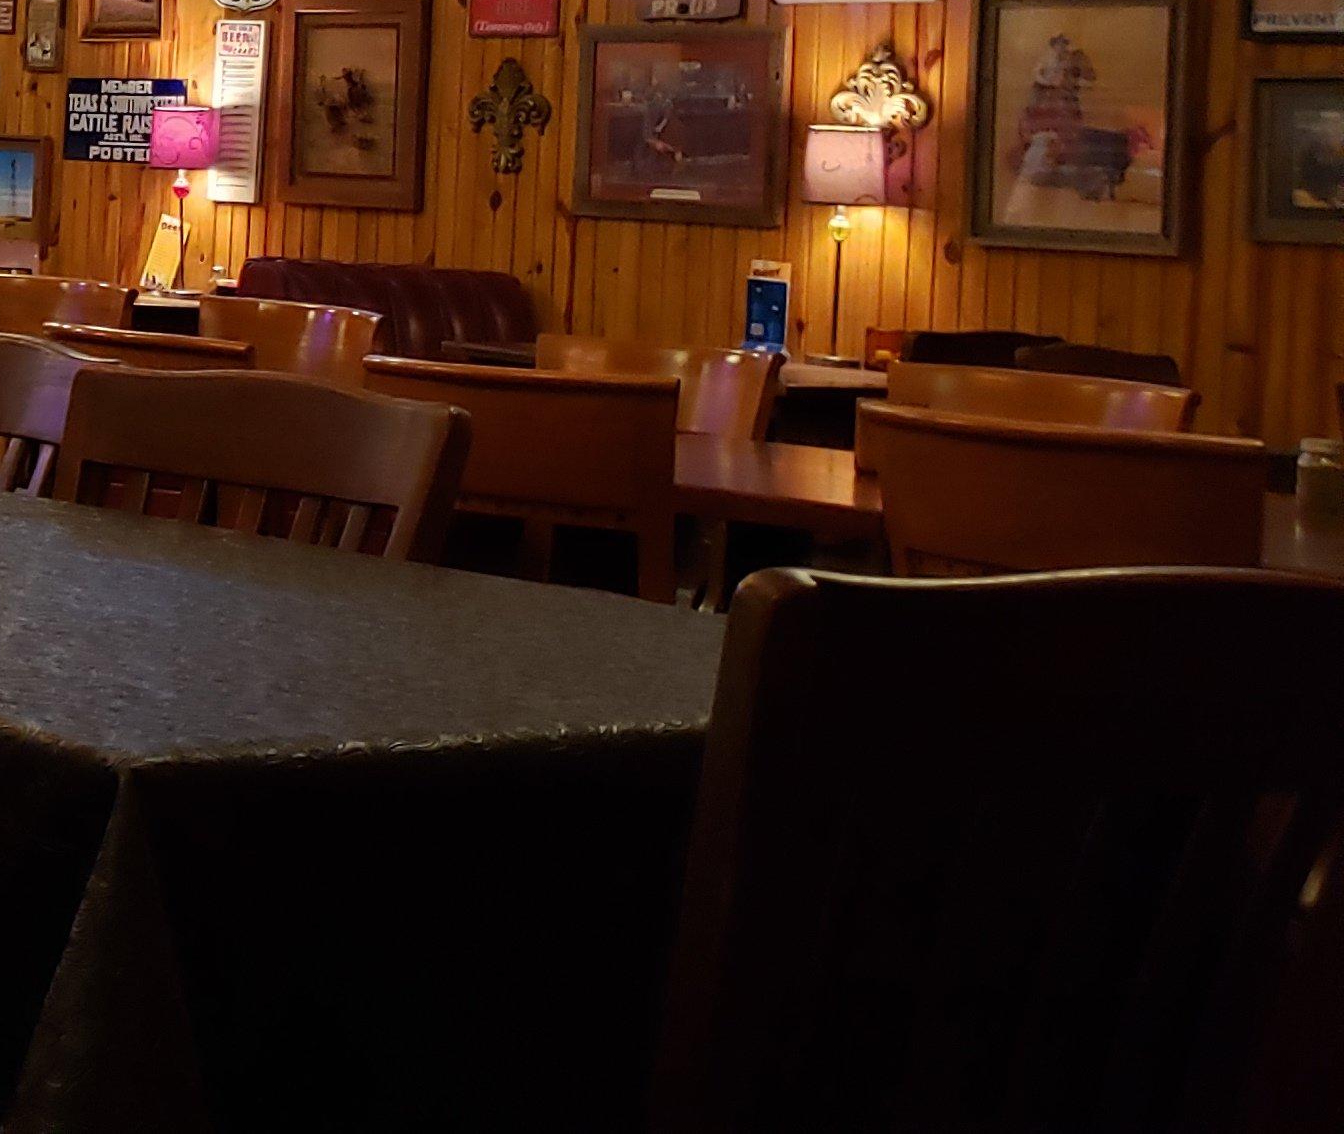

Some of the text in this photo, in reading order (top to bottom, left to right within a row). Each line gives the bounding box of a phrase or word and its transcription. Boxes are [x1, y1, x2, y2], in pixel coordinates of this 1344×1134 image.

[100, 79, 153, 94] MEMBER
[68, 93, 99, 113] TEXAS
[69, 113, 153, 134] CATTLE RAIS
